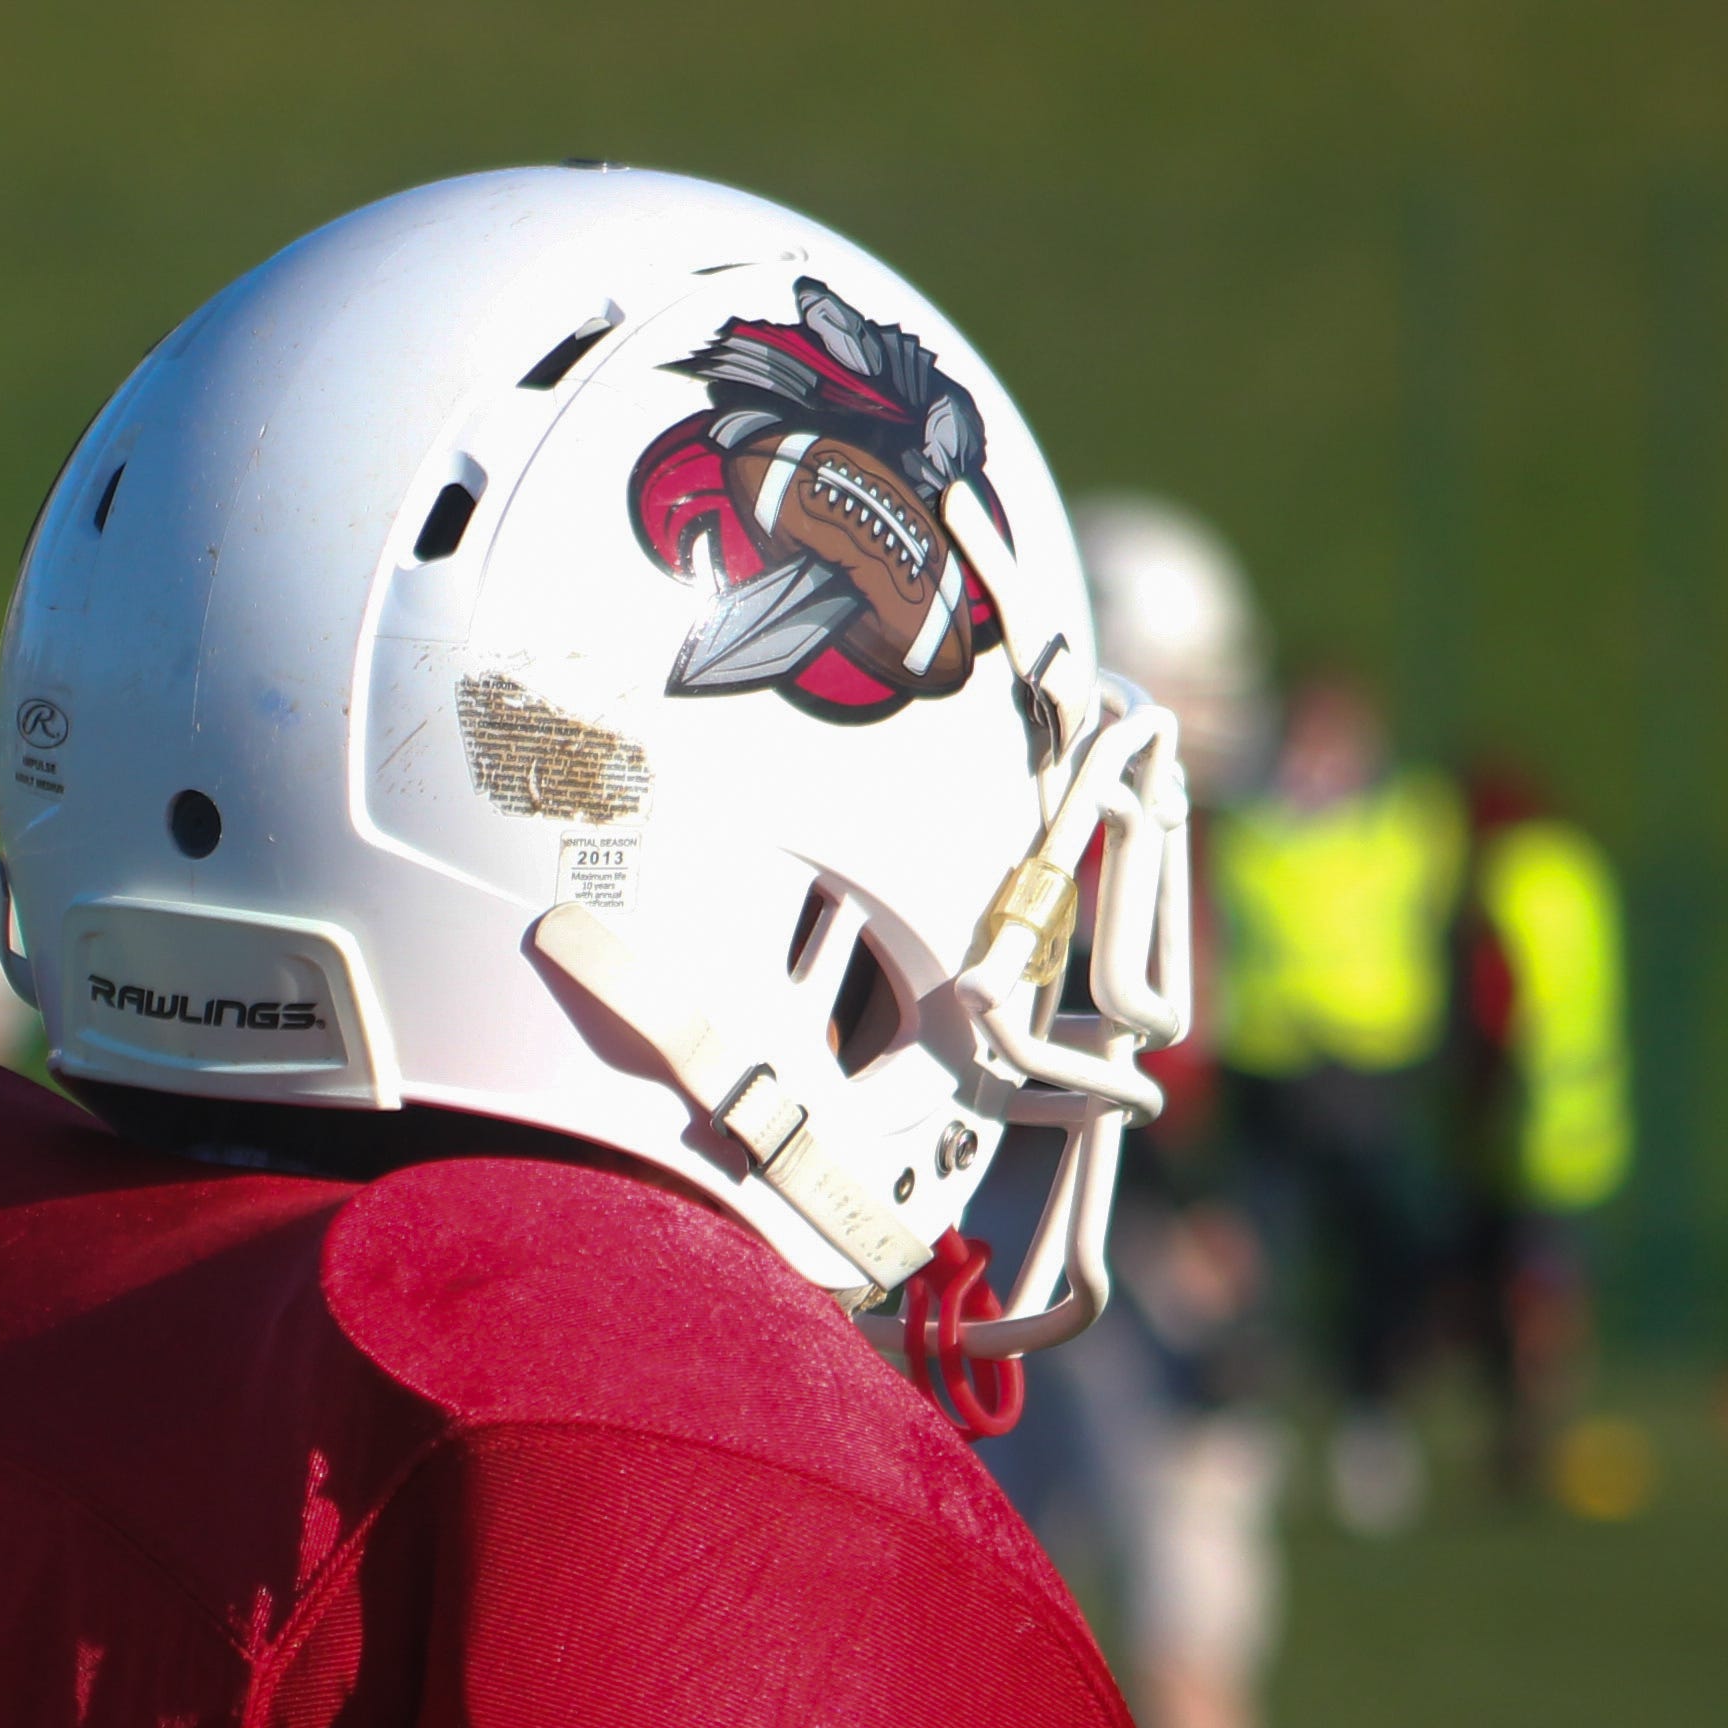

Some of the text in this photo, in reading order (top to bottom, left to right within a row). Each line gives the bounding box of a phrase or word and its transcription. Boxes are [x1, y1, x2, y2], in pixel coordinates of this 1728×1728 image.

[600, 838, 637, 847] SEASON
[577, 851, 623, 865] 2013
[571, 872, 612, 880] Maximum
[583, 882, 592, 890] 10
[88, 974, 319, 1031] RAWLINGS
